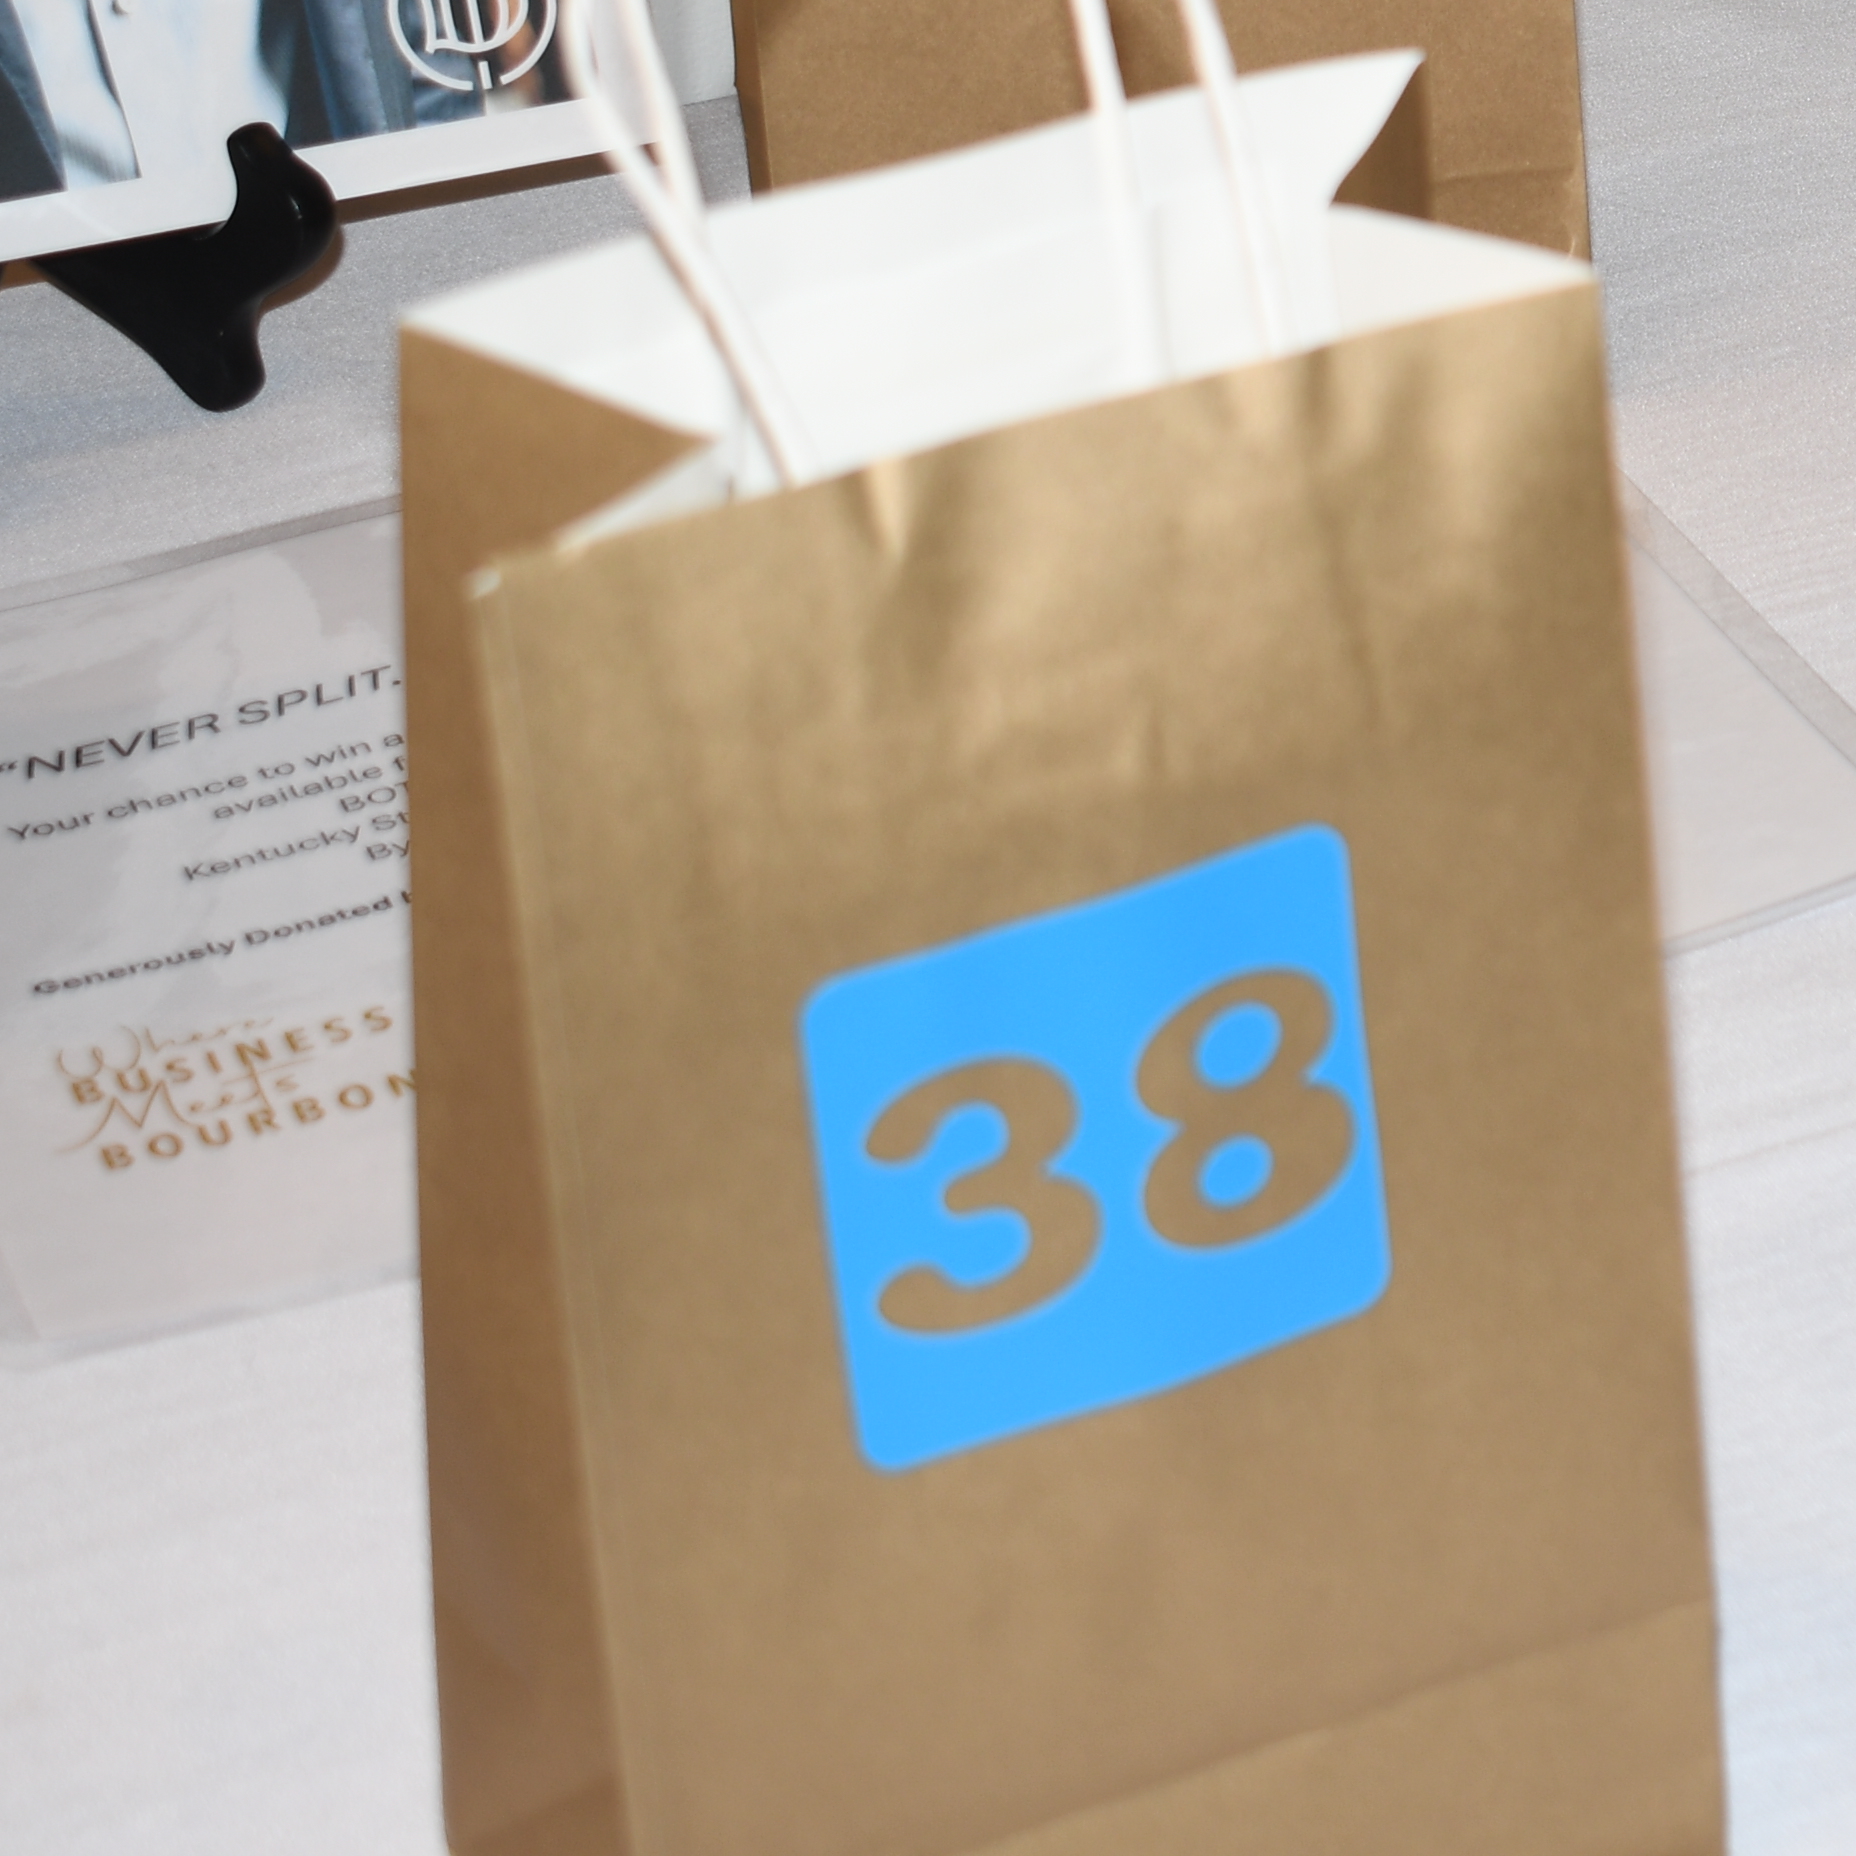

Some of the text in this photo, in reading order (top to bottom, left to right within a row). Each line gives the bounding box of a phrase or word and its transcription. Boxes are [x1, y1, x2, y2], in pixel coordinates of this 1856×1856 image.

[7, 812, 95, 841] Your
[107, 775, 249, 819] chance
[258, 762, 296, 780] to
[304, 741, 372, 768] win
[213, 766, 384, 821] available
[183, 825, 361, 881] Kentucky
[32, 895, 394, 995] Generously Donated
[71, 1005, 394, 1105] BUSINESS
[101, 1068, 417, 1171] BOURBON
[864, 965, 1357, 1336] 38
